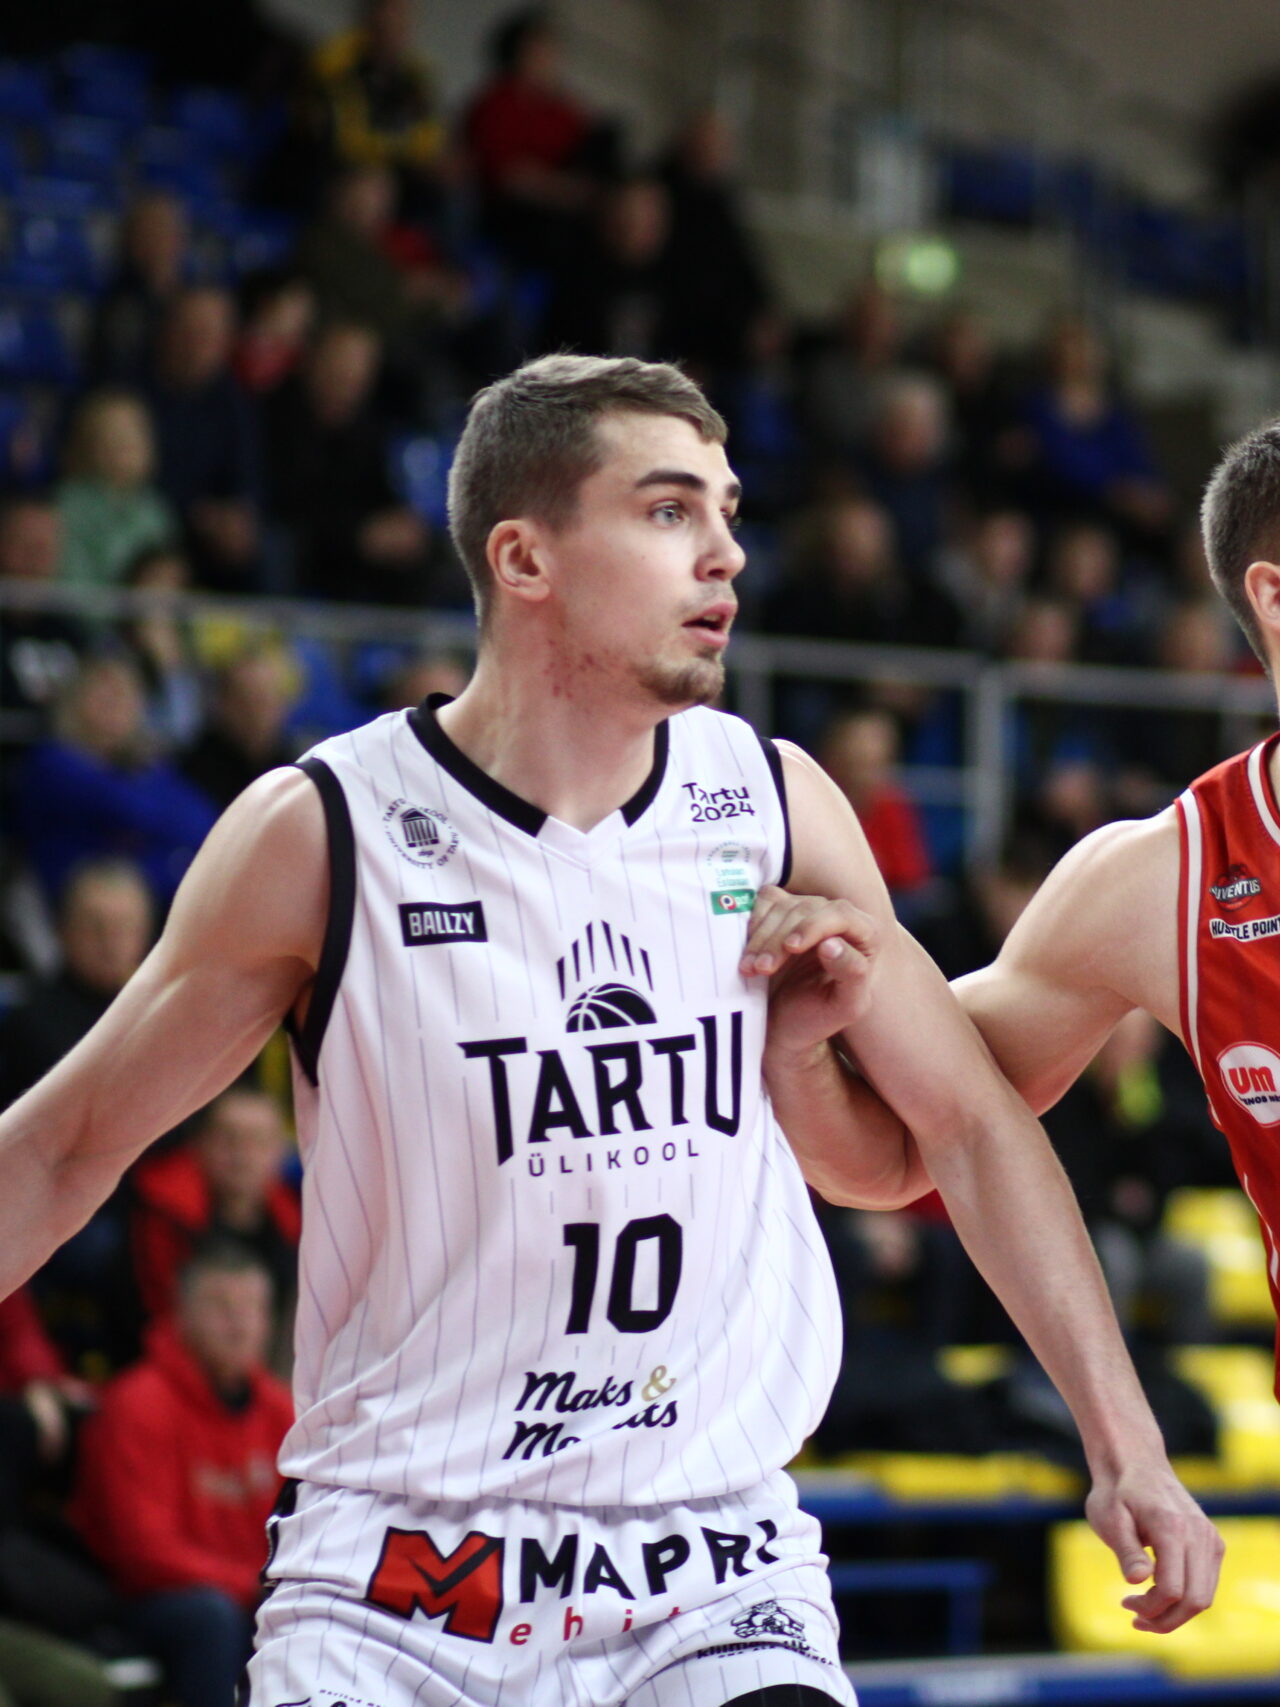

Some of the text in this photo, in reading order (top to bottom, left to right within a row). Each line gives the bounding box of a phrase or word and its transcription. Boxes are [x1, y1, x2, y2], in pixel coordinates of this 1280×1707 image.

[690, 801, 755, 822] 2024
[408, 911, 475, 937] BALLZY
[1211, 920, 1250, 940] HUSTLE
[455, 1010, 743, 1167] TARTU
[528, 1139, 700, 1177] ÜLIKOOL
[563, 1213, 683, 1335] 10
[514, 1364, 677, 1413] Maks &
[519, 1518, 782, 1603] MAPRI
